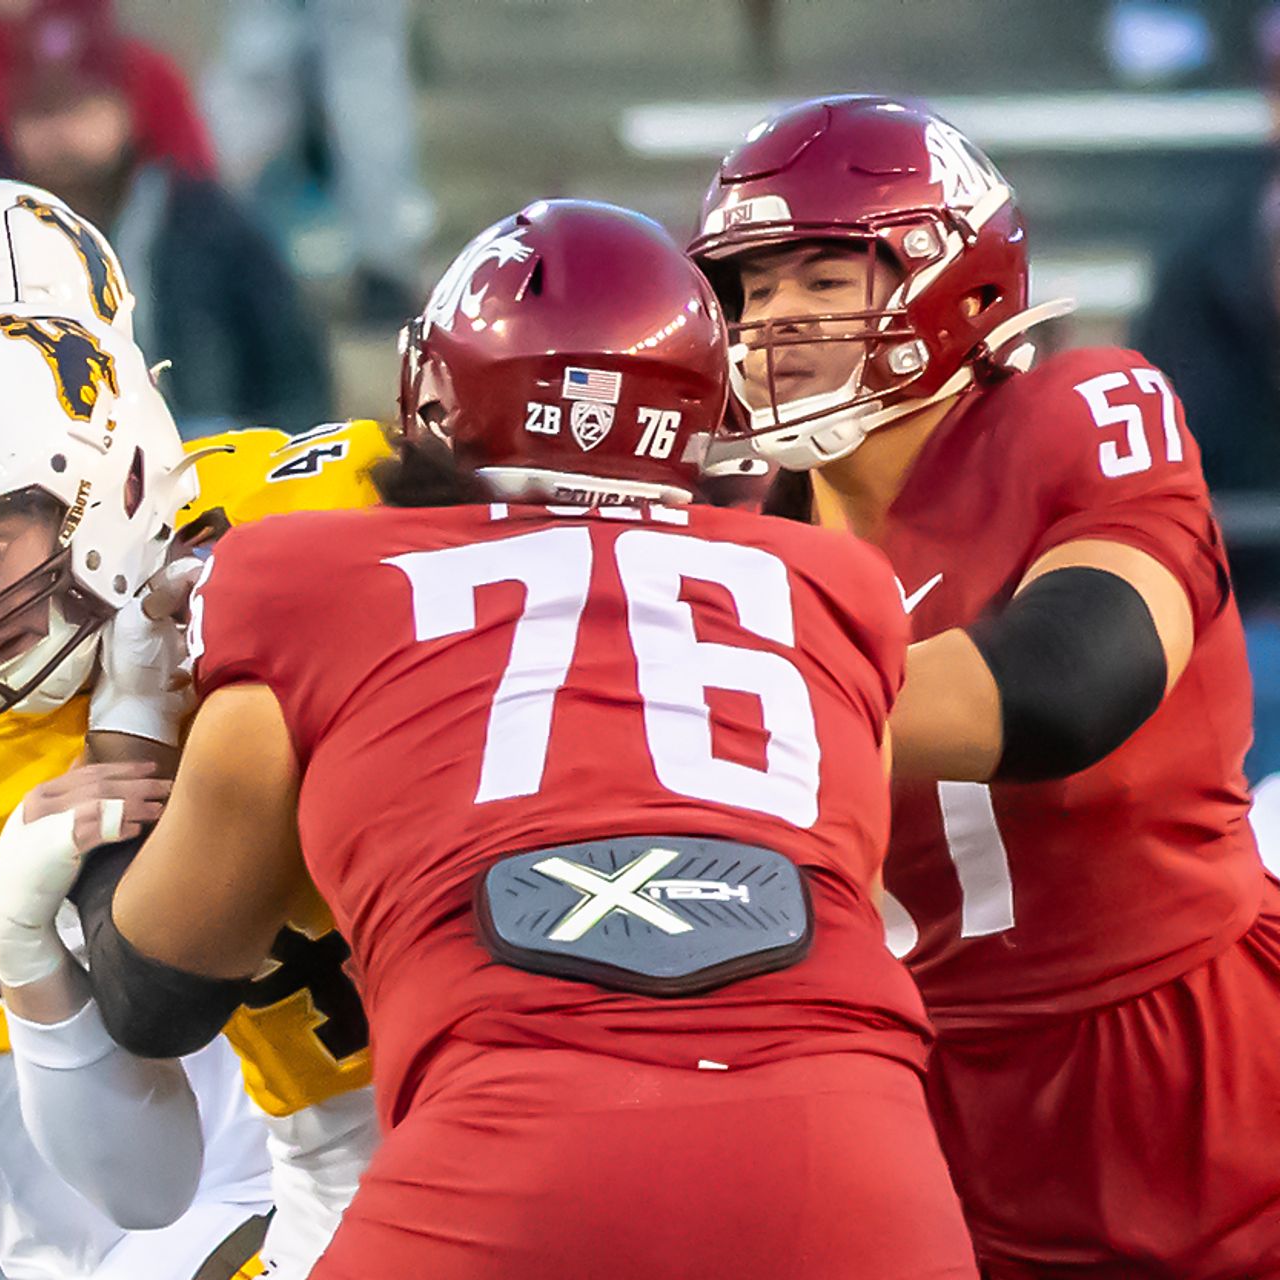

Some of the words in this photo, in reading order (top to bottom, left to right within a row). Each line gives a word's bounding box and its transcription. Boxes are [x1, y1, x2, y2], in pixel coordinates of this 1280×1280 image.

[634, 407, 682, 459] 76
[1073, 368, 1183, 478] 57
[380, 526, 820, 829] 76
